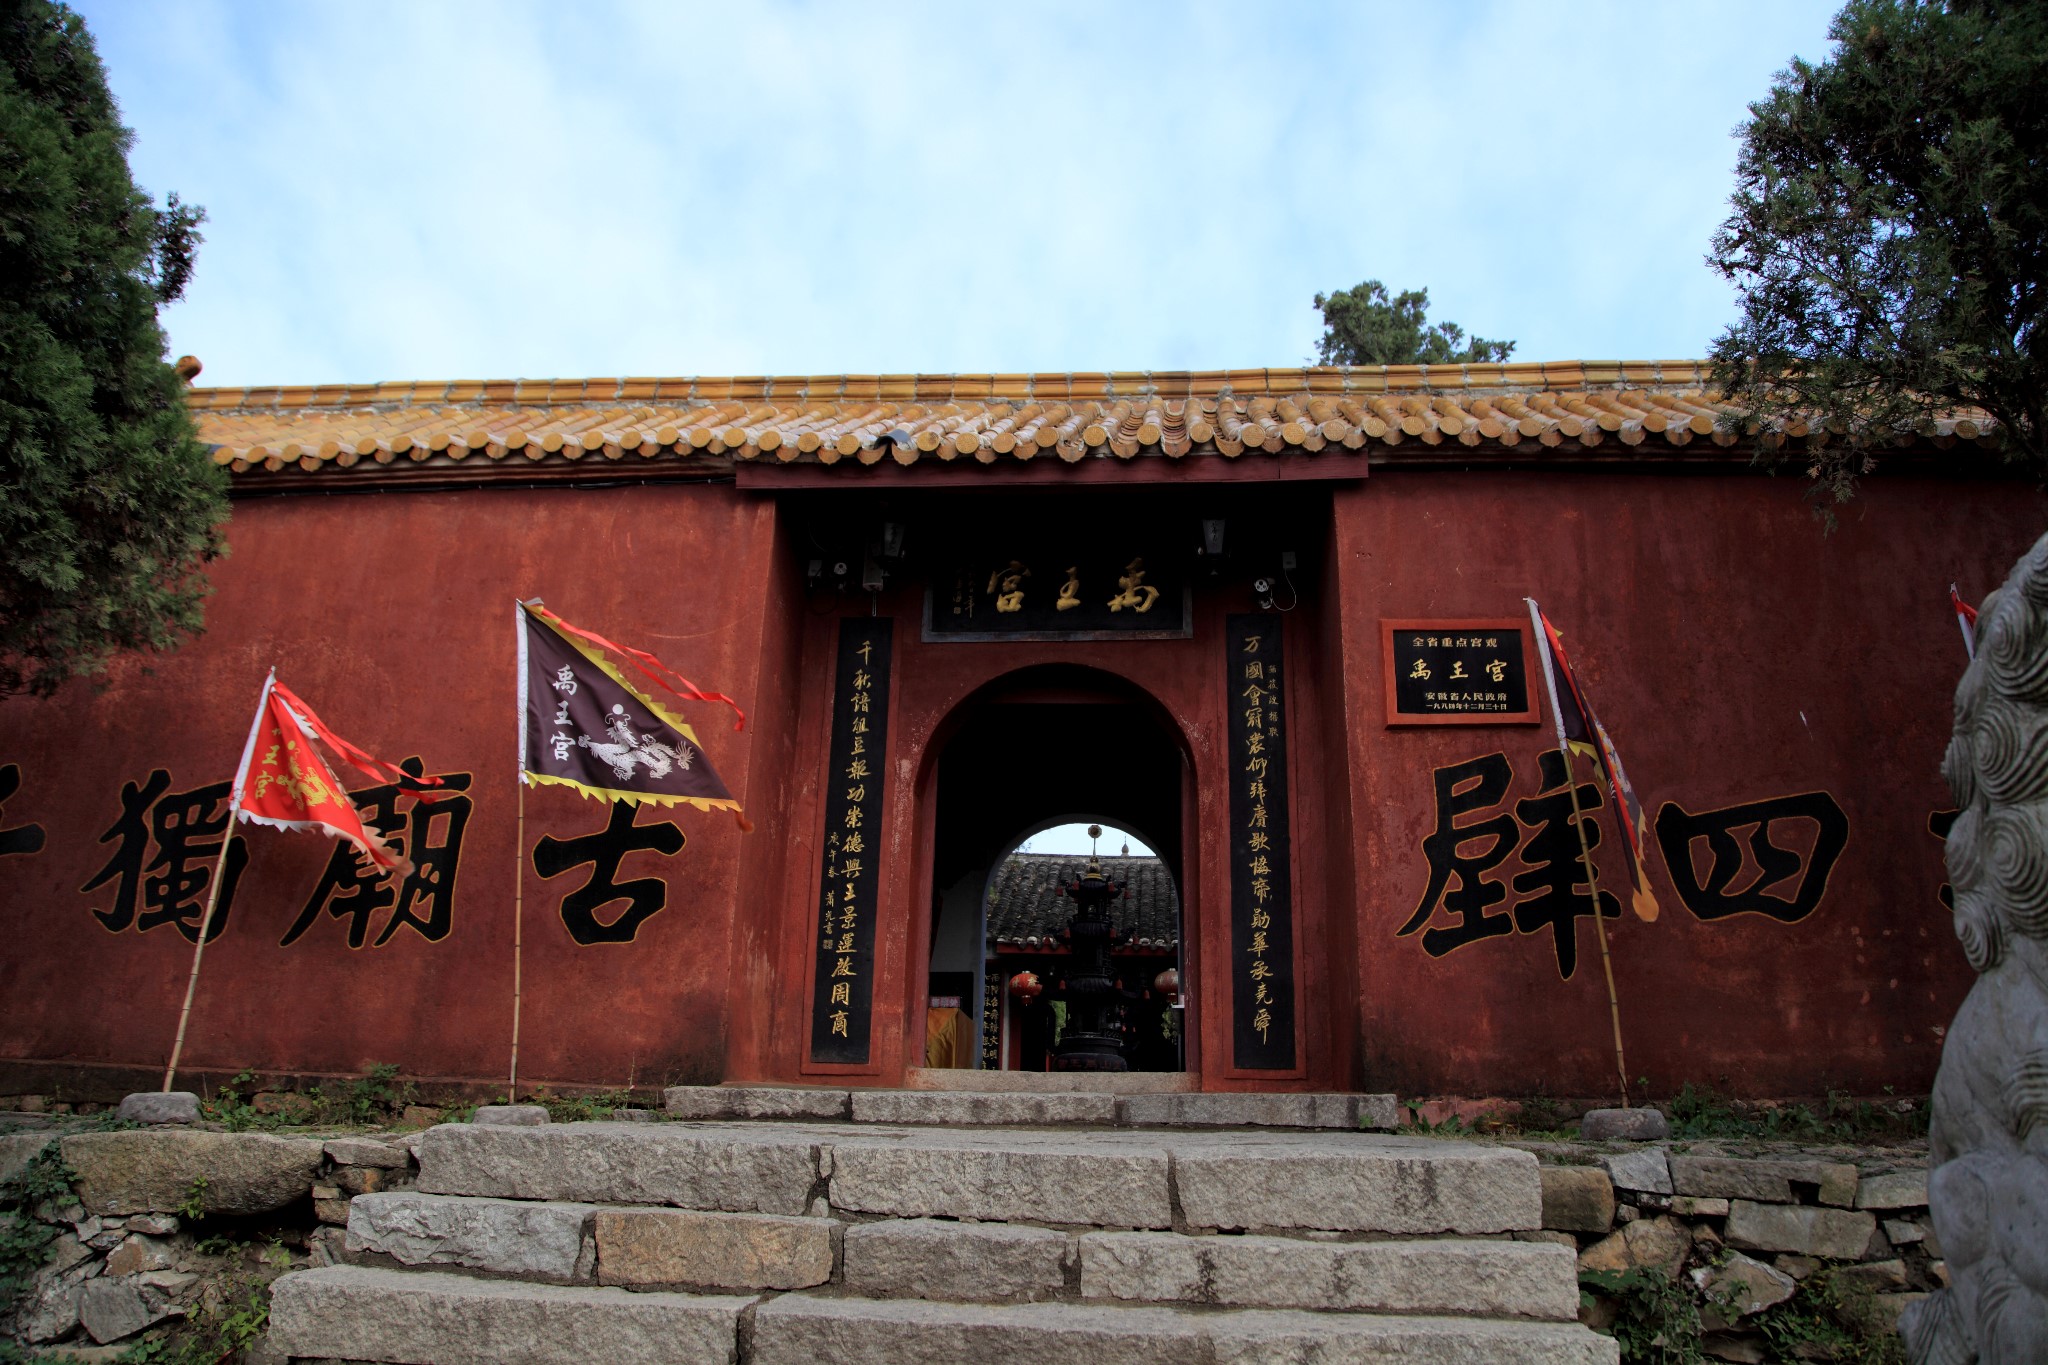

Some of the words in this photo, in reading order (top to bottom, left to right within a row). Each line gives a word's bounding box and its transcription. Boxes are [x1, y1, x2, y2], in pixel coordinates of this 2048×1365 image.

[1412, 636, 1498, 648] 全省重点宫观
[1425, 691, 1508, 702] 安徽省人民政府
